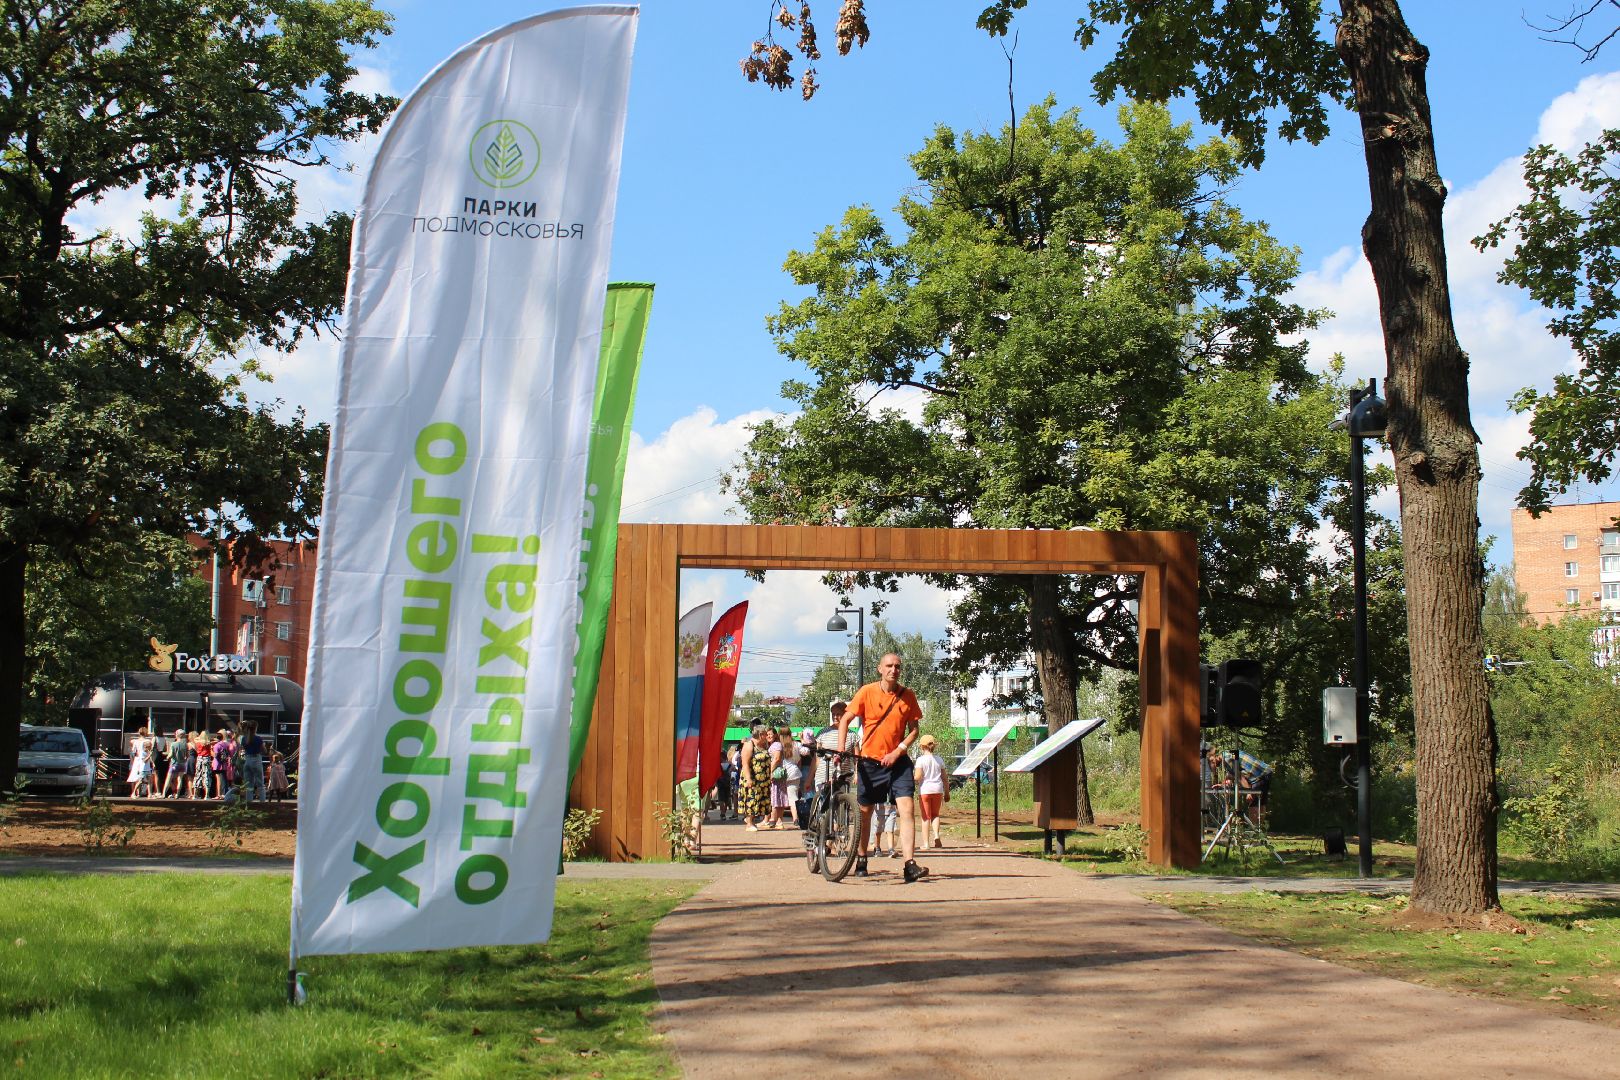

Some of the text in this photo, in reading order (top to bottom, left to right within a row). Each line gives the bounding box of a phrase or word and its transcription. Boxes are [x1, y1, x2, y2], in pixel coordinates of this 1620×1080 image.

[463, 197, 538, 218] ПАРКИ
[411, 216, 584, 240] ПОДМОСКОВЬЯ
[174, 652, 252, 673] Fox Box
[347, 421, 467, 909] Хорошего
[454, 533, 541, 905] отдыха!
